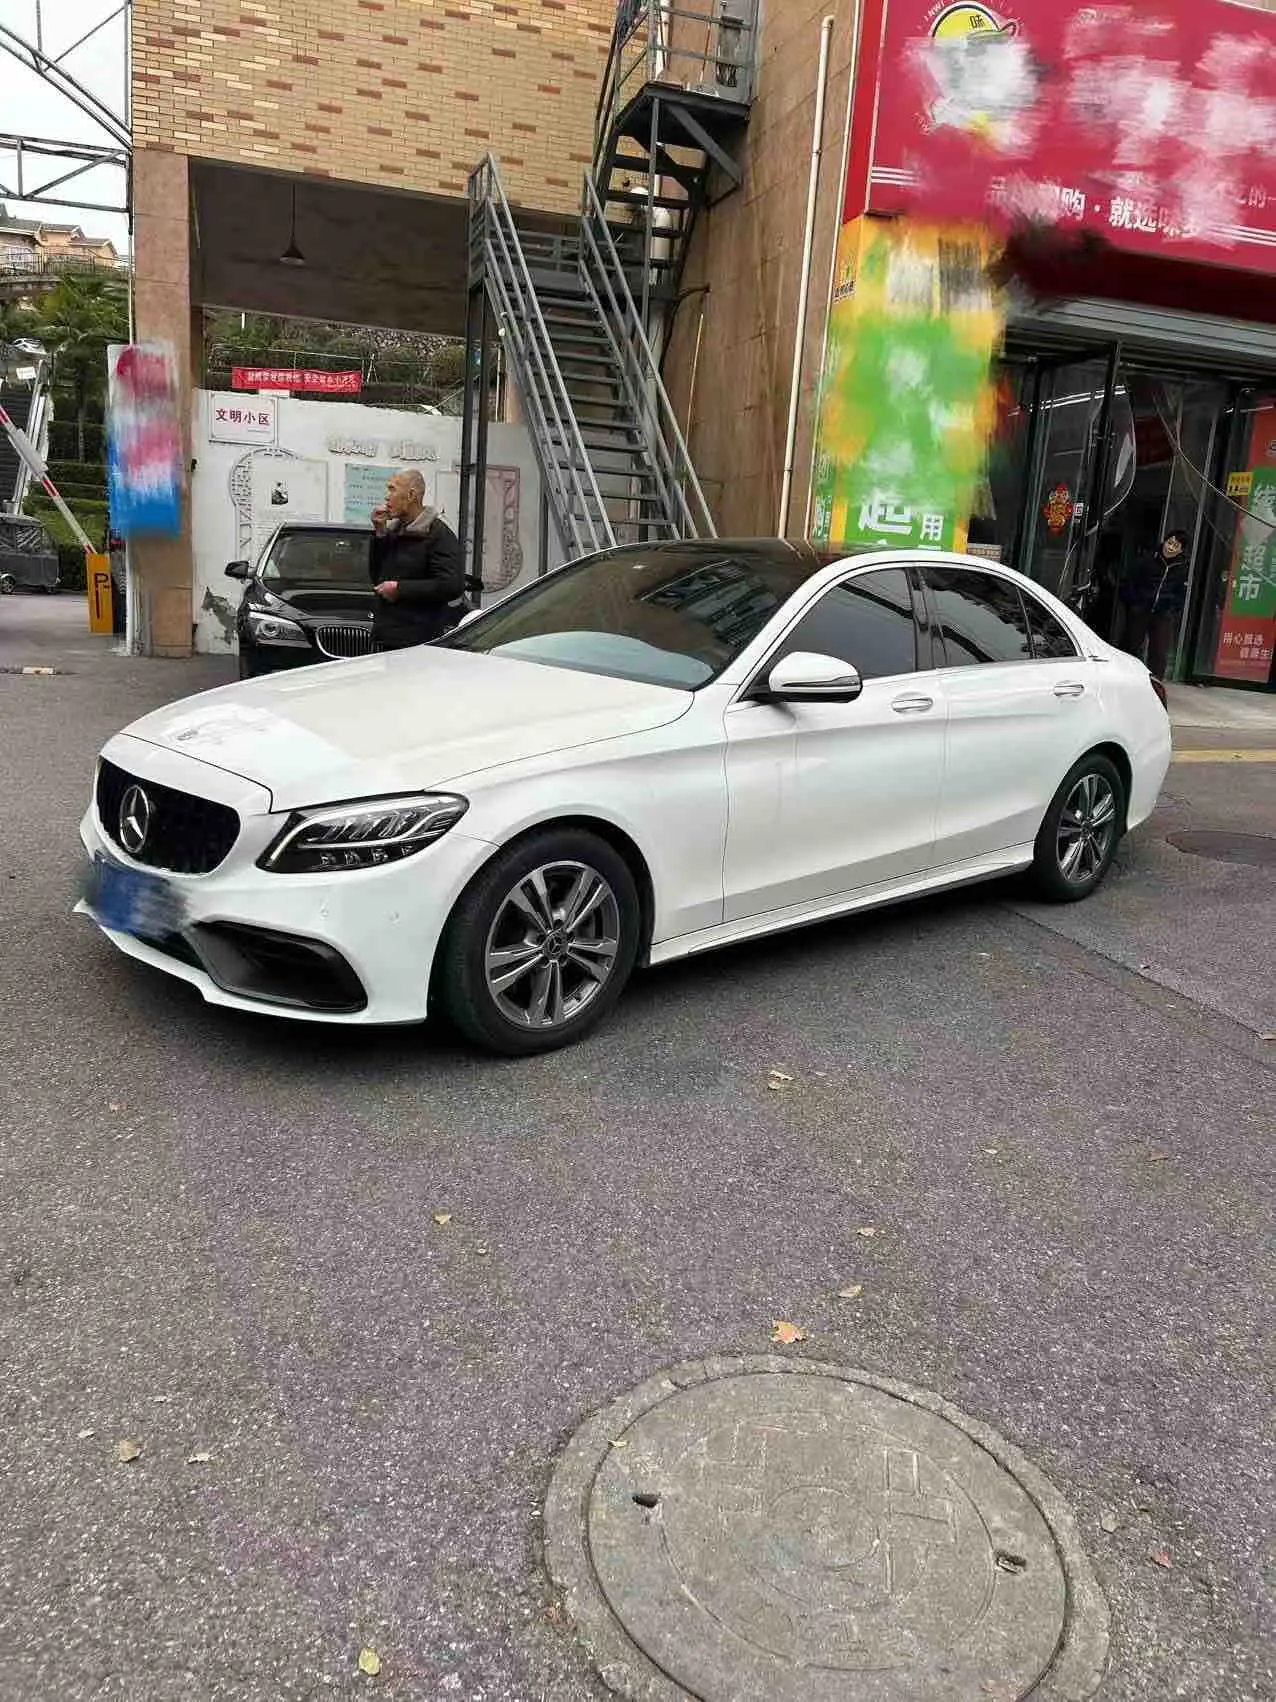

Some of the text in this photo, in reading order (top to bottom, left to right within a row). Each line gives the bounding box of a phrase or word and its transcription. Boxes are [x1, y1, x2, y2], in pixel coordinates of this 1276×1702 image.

[215, 408, 271, 426] 文明小区
[919, 513, 946, 541] 用
